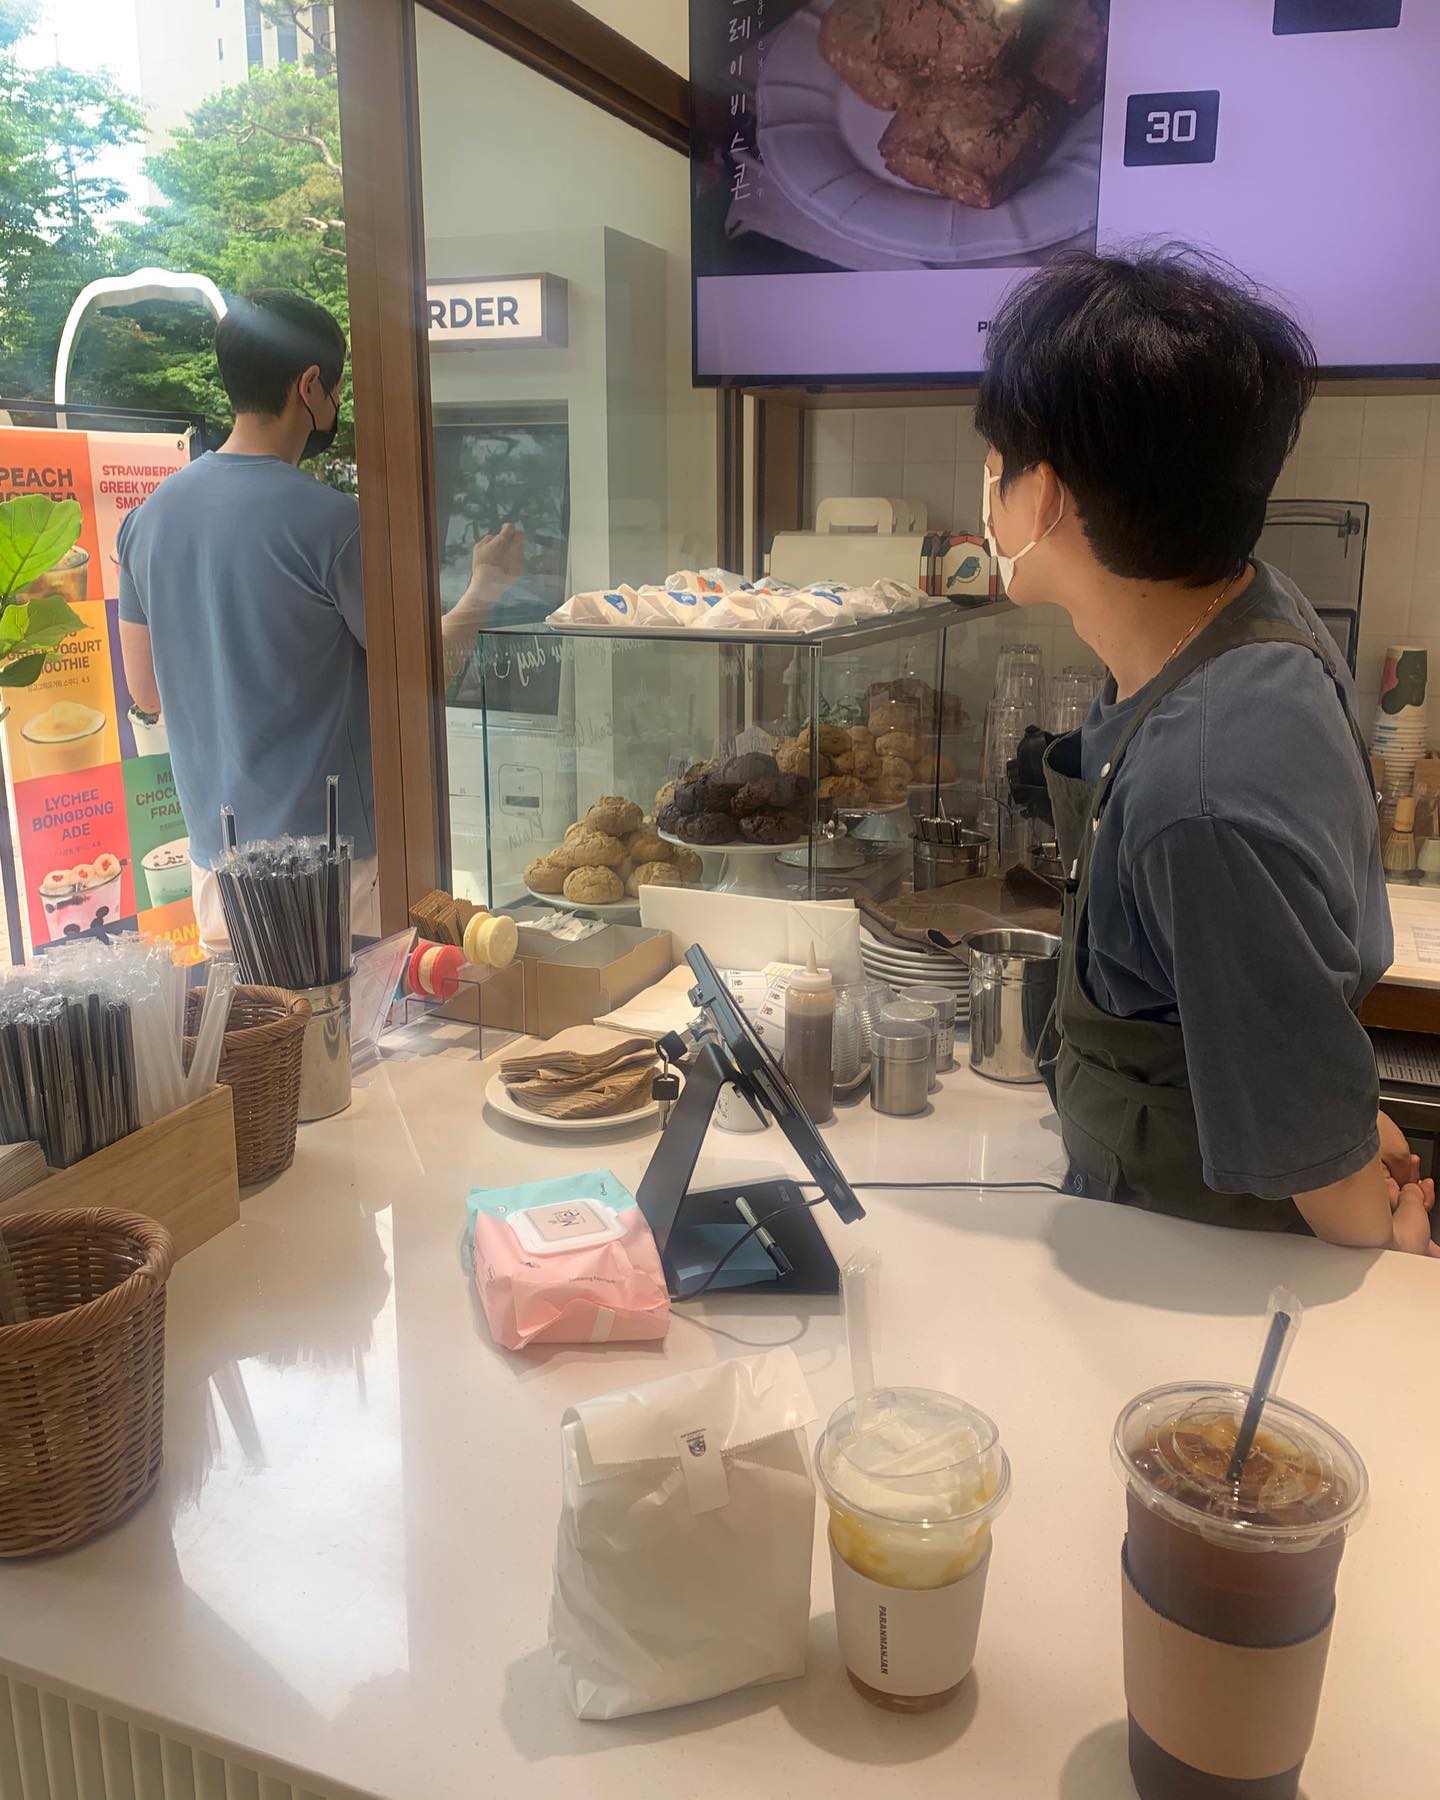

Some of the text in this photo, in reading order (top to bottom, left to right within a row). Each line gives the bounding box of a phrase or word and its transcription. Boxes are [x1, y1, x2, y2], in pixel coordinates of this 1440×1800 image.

[728, 0, 752, 201] 레이비스콘
[1145, 109, 1197, 144] 30
[427, 296, 520, 329] RDER
[0, 467, 73, 488] PEACH
[99, 481, 138, 494] GREEK
[41, 656, 90, 675] OOTHIE
[45, 788, 99, 812] LYCHEE
[32, 800, 114, 832] BONGBONG
[62, 822, 90, 841] ADE
[879, 1605, 888, 1675] PARANMANJAN
